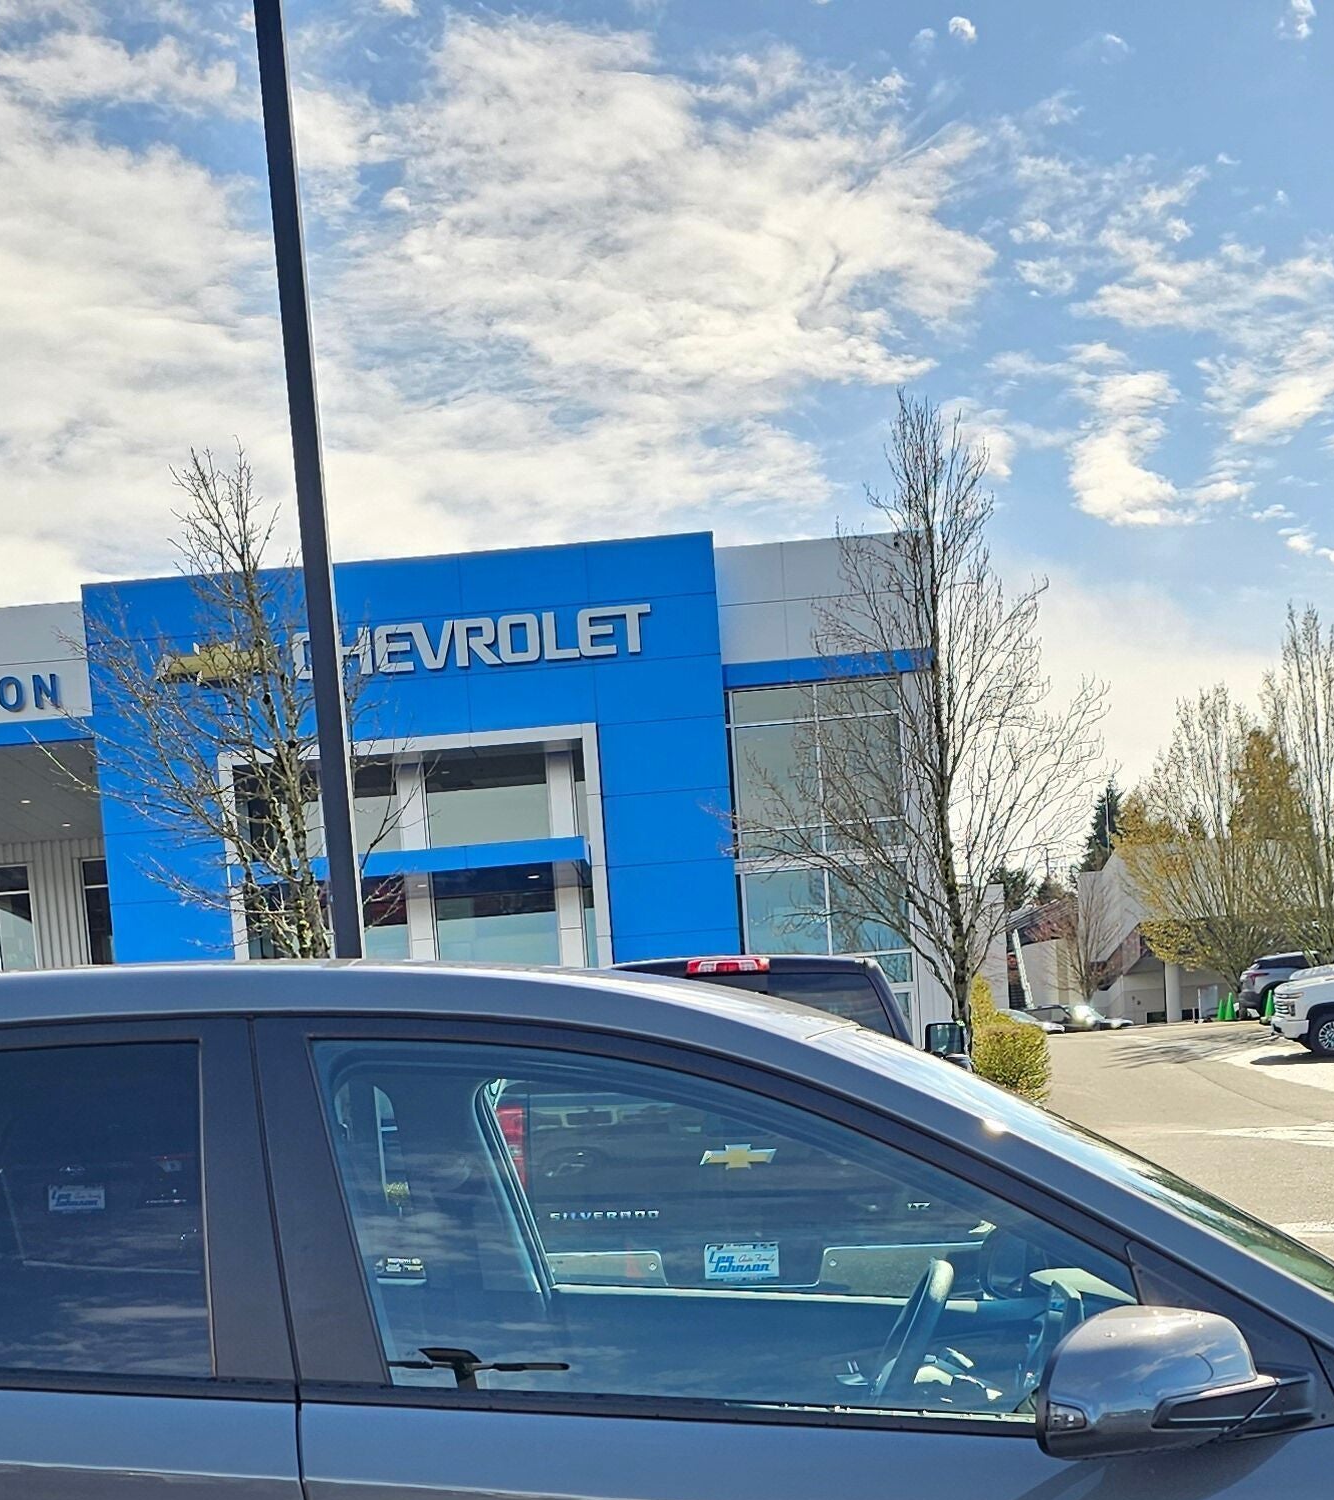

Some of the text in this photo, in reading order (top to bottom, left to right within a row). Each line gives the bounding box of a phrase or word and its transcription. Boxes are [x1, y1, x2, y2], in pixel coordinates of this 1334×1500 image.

[291, 603, 651, 680] CHEVROLET
[550, 1209, 660, 1220] SILVERADO
[710, 1262, 771, 1272] Johnson
